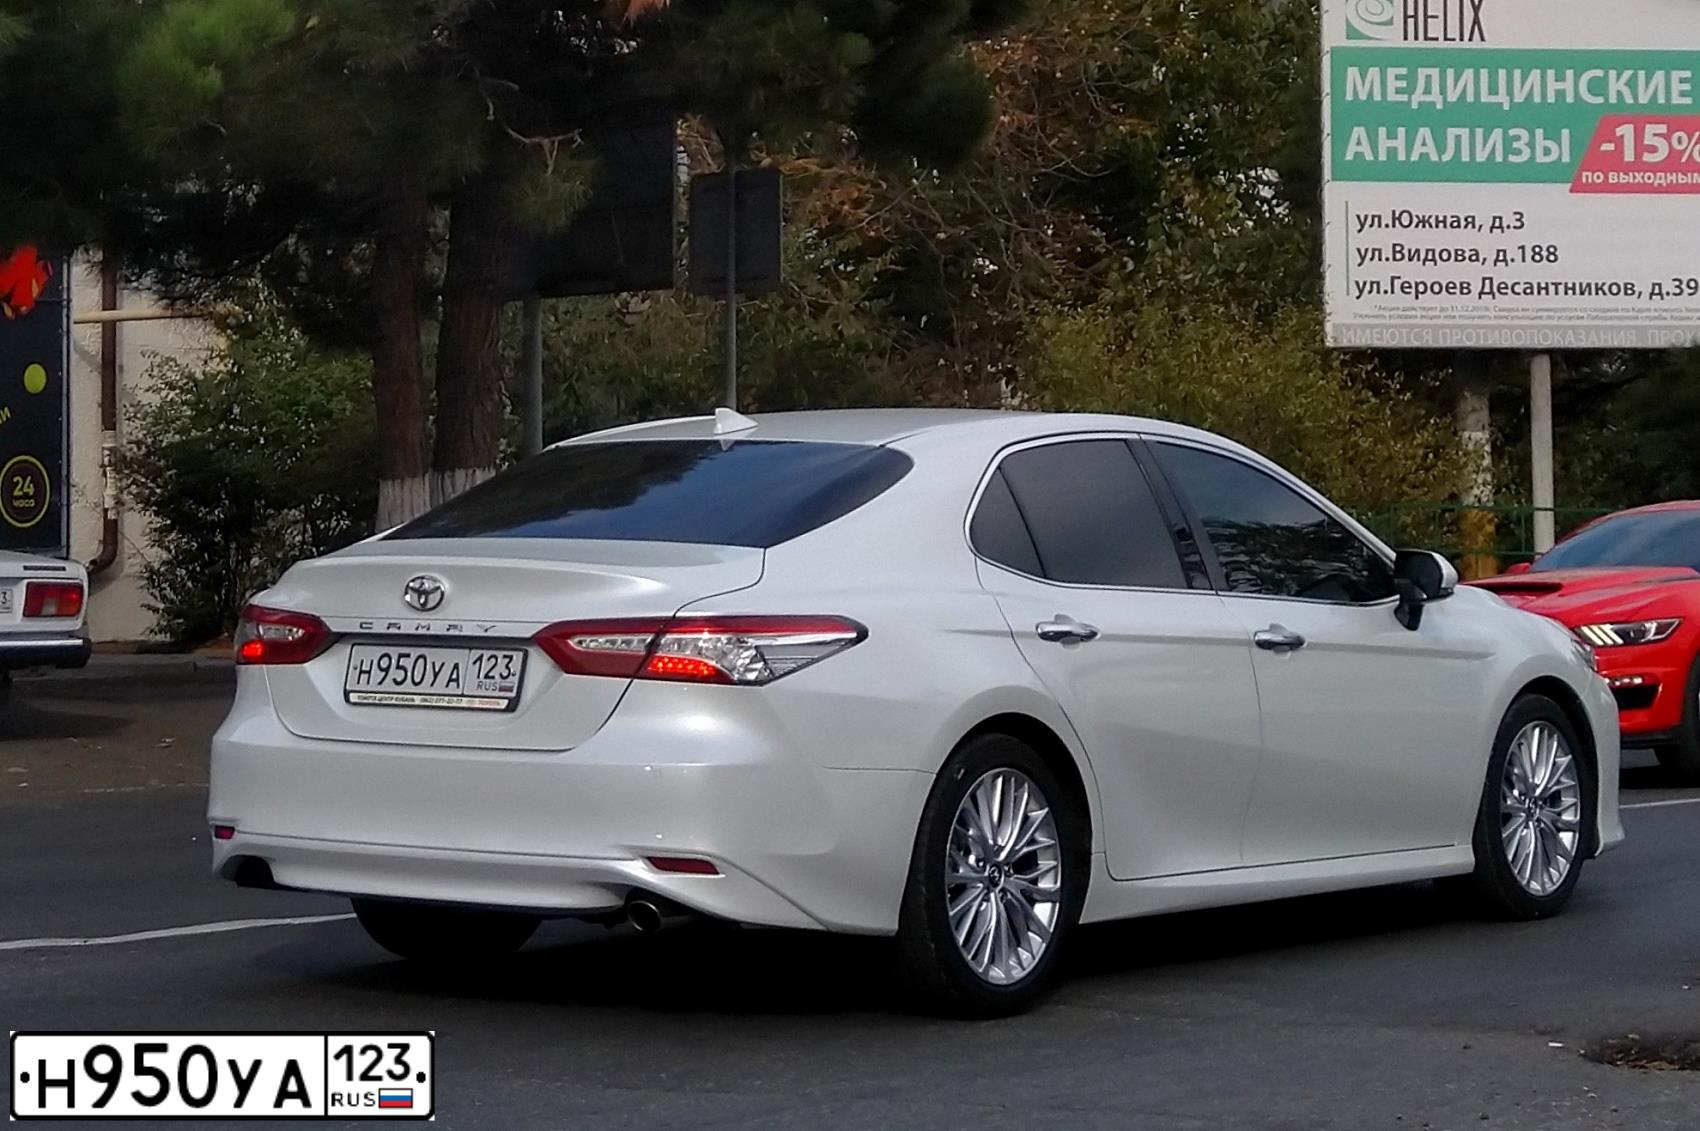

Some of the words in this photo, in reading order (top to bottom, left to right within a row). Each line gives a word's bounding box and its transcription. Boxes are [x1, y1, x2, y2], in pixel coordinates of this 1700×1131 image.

[1402, 0, 1487, 42] HELIX
[1345, 66, 1693, 110] МЕДИЦИНСКИЕ
[1344, 126, 1571, 163] АНАЛИЗЫ
[1600, 123, 1700, 163] -15%
[1355, 209, 1484, 233] ул.Южная,
[1489, 211, 1526, 233] д.3
[1355, 243, 1488, 266] ул.Видова,
[1493, 245, 1559, 267] д.188
[1354, 275, 1472, 300] ул.Героев
[1478, 277, 1643, 300] Десантников,
[1649, 278, 1699, 300] д.39
[1342, 327, 1432, 345] ИМЕЮТСЯ
[13, 476, 35, 496] 24
[359, 621, 497, 632] CAMRY
[472, 654, 514, 680] 123
[476, 680, 498, 691] RUS
